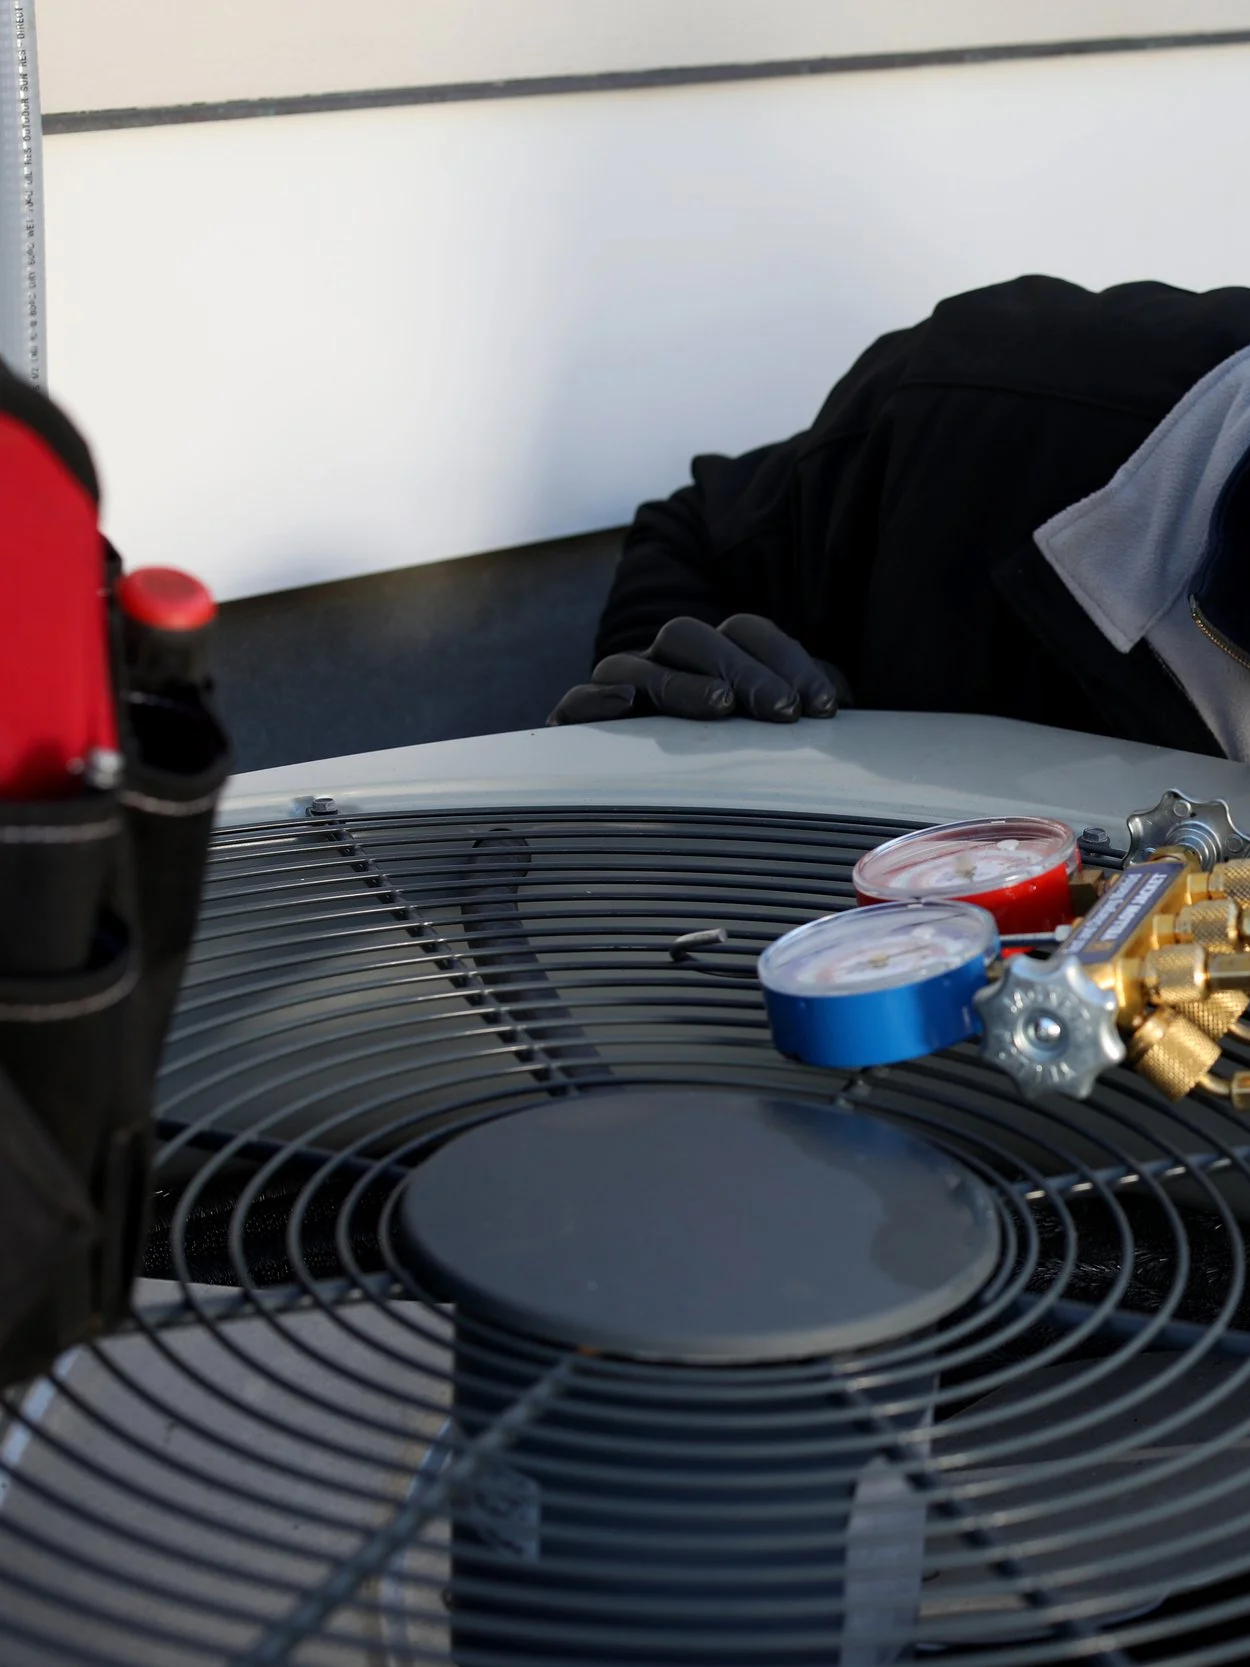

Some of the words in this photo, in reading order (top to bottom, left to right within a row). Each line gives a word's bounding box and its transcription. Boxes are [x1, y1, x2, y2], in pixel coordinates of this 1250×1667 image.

[15, 7, 25, 40] DIRECT
[18, 49, 27, 67] RES
[20, 73, 29, 92] SUN
[21, 98, 31, 141] OUTDOOR
